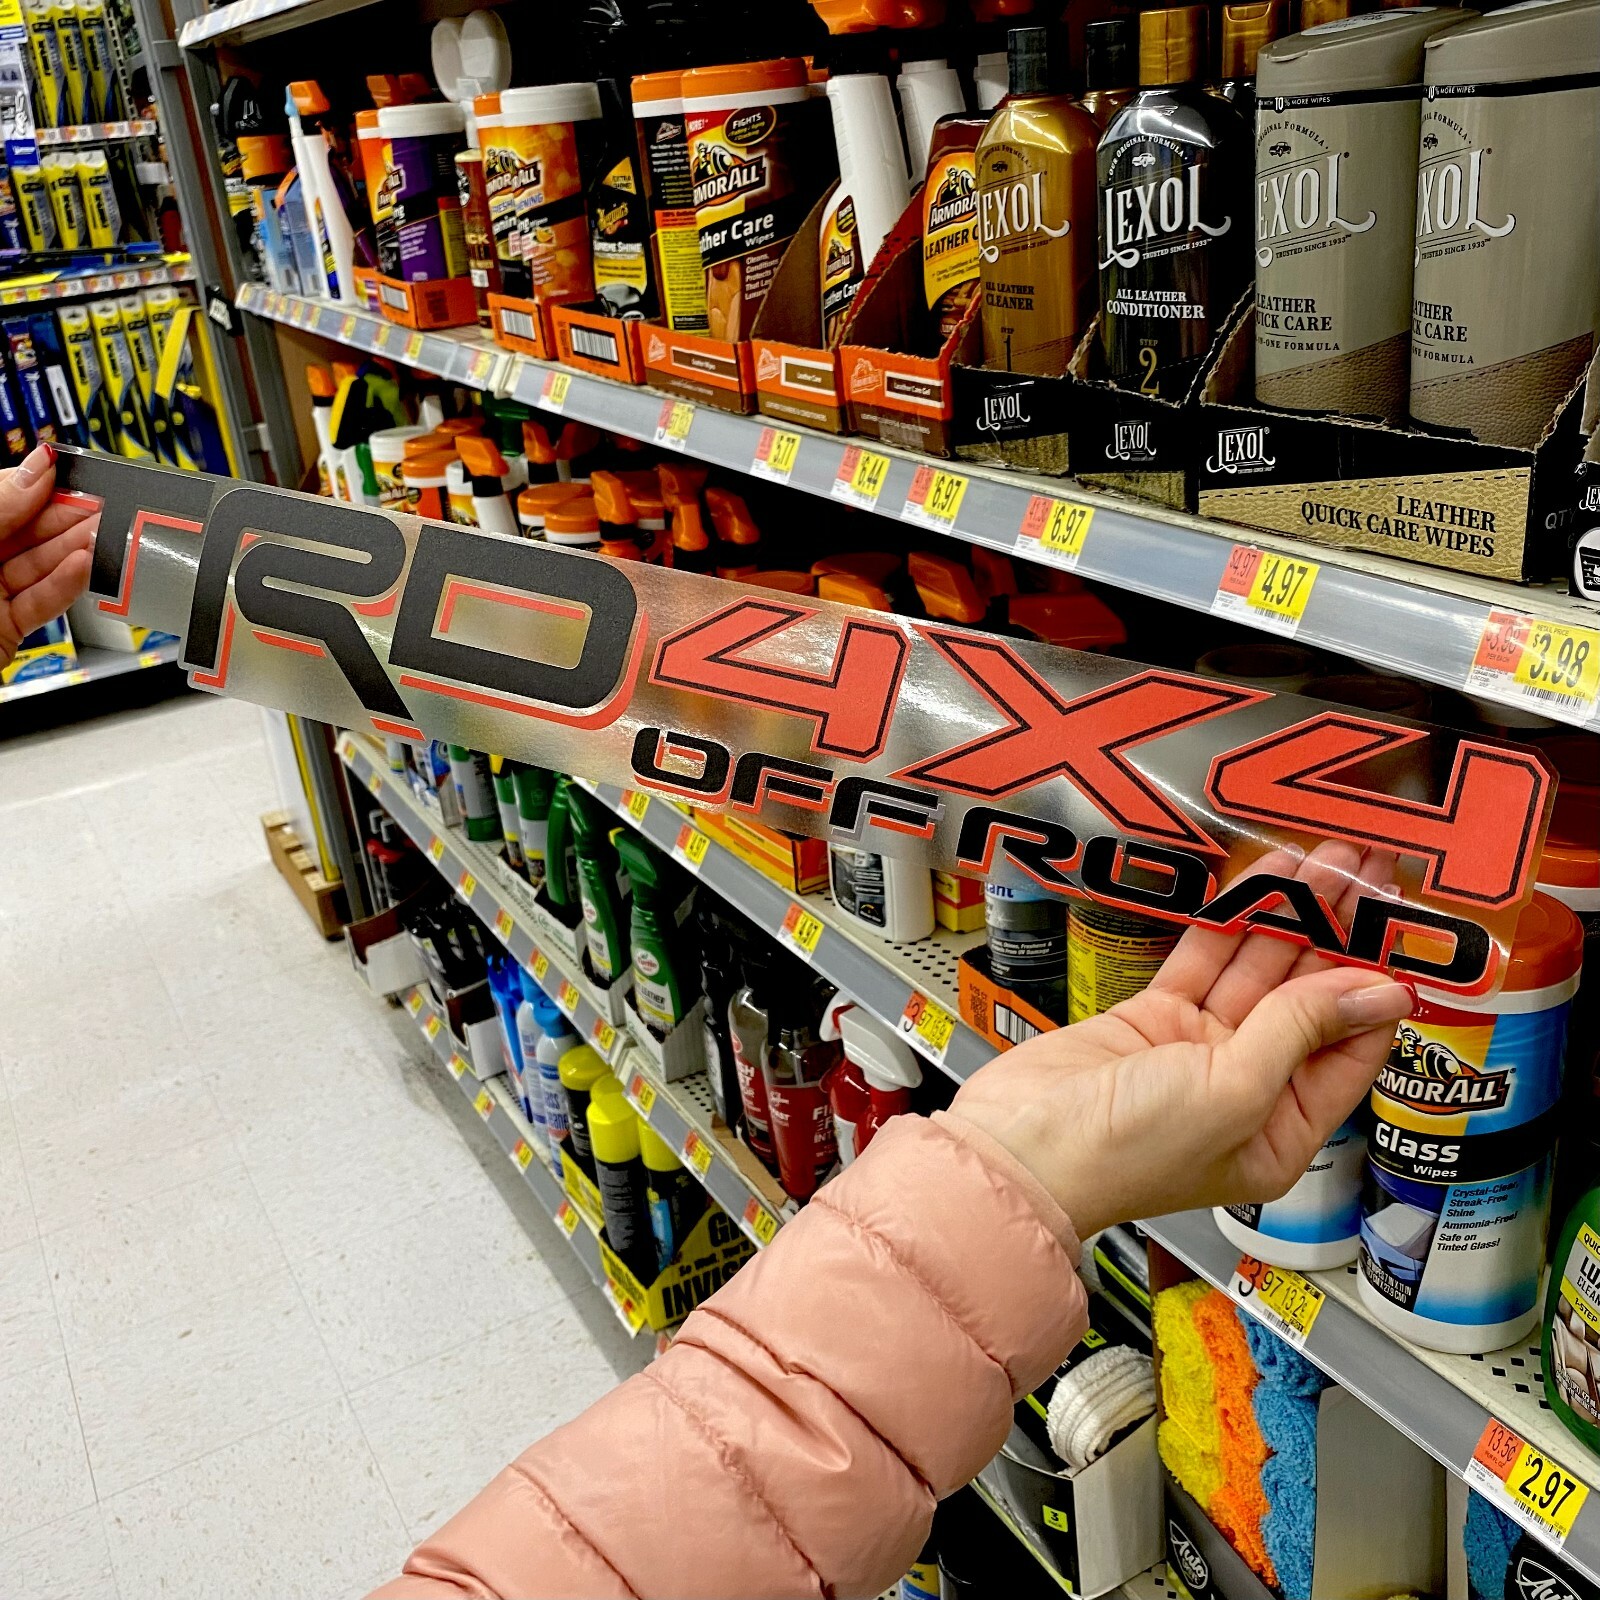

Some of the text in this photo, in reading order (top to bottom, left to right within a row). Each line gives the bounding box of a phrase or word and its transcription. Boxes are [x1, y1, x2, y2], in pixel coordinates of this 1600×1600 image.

[1456, 86, 1476, 94] WIPES
[733, 113, 762, 130] FIGHTS
[1433, 112, 1468, 141] FORMULA
[1284, 121, 1325, 148] FORMULA
[1116, 136, 1146, 158] ORIGINAL
[1148, 136, 1185, 157] FORMULA
[930, 190, 978, 227] ARMORA
[979, 172, 1071, 262] LEXOL
[1098, 165, 1232, 270] LEXOL
[1256, 153, 1377, 268] EXOL
[731, 212, 774, 241] Care
[745, 231, 775, 248] Wipes
[925, 229, 969, 261] LEATHER
[1276, 247, 1303, 259] TRUSTED
[1304, 242, 1327, 253] SINCE
[1444, 244, 1466, 255] SINCE
[1142, 249, 1169, 260] TRUSTED
[1170, 244, 1190, 255] SINCE
[997, 283, 1035, 295] LEATHER
[1115, 288, 1187, 303] ALL LEATHER
[985, 293, 1034, 311] CLEANER
[1106, 299, 1206, 320] CONDITIONER
[1256, 293, 1317, 313] LEATHER
[1413, 300, 1454, 322] ATHER
[1284, 315, 1333, 331] CARE
[1424, 322, 1468, 342] CARE
[1139, 338, 1159, 346] STEP
[1284, 341, 1341, 351] FORMULA
[1424, 351, 1475, 364] FORMULA
[1138, 347, 1160, 395] 2
[976, 392, 1031, 431] LEXOL
[1105, 421, 1157, 461] LEXOL
[1396, 494, 1497, 534] LEATHER
[1301, 500, 1495, 558] QUICK CARE WIPES
[1229, 549, 1258, 578] $4.97
[1261, 559, 1309, 608] $4.97
[1536, 624, 1570, 637] RETAIL PRICE
[1529, 632, 1590, 688] $3.98
[52, 443, 1553, 909] TRD 4X4
[630, 726, 1500, 1000] OFF ROAD
[1377, 1071, 1499, 1104] RMORALL
[1375, 1121, 1461, 1164] Glass
[1413, 1163, 1458, 1179] Wipes
[1449, 1193, 1509, 1208] Streak-Free
[1452, 1181, 1519, 1198] Crystal-Clear,
[1442, 1211, 1519, 1230] Ammonia-Free!
[1446, 1208, 1476, 1218] Shine
[1436, 1237, 1501, 1252] Tinted Glass!
[1439, 1232, 1477, 1242] Safe on
[1576, 1274, 1600, 1307] CLEAN
[1486, 1425, 1518, 1463] 13.5¢
[1518, 1453, 1577, 1517] $2.97
[1050, 1510, 1060, 1522] 3
[1172, 1536, 1207, 1579] Auto
